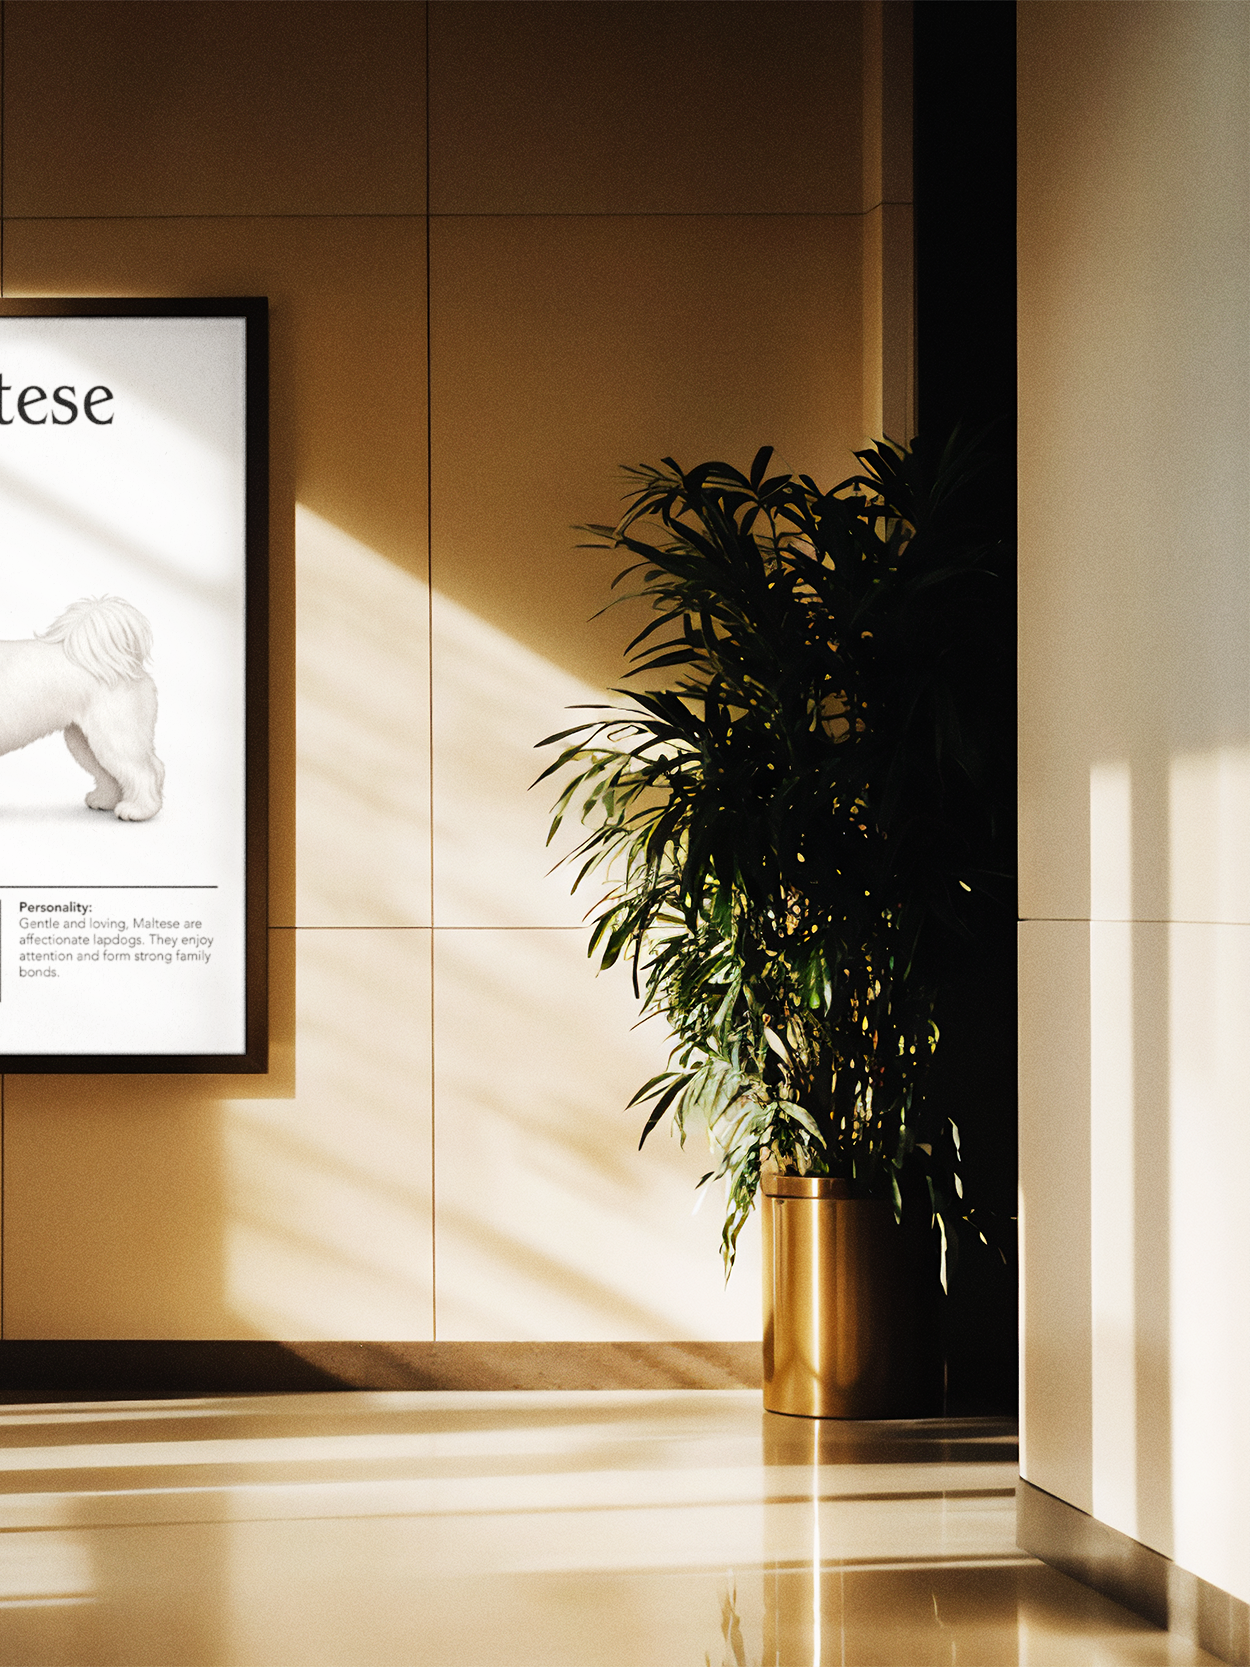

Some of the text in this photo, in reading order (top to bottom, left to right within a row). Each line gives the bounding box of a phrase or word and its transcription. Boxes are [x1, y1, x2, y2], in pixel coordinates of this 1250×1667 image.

[19, 901, 93, 915] Personality:
[18, 918, 203, 933] Gentle and loving, Maltese are
[19, 933, 214, 949] affectionate lapdogs. They enjoy
[19, 950, 212, 965] attention and form strong family
[18, 966, 60, 978] bonds.
